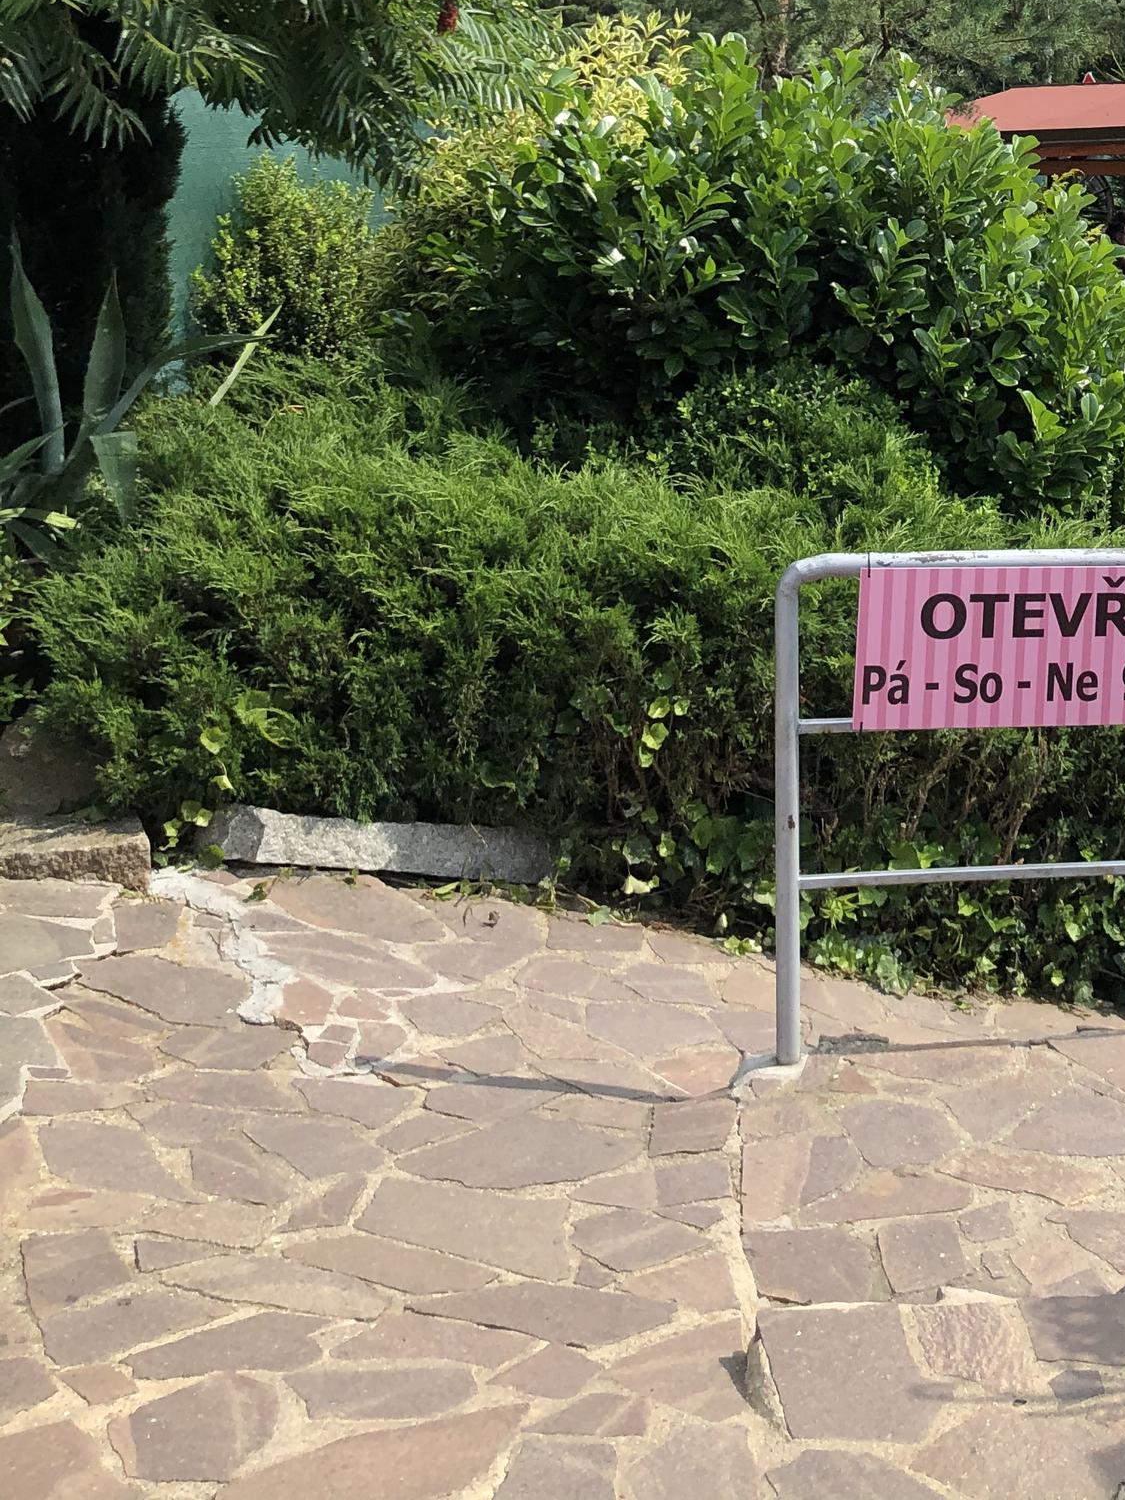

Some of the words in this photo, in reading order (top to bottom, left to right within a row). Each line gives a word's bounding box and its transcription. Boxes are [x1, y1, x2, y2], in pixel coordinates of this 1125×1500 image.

[862, 660, 910, 705] Pá
[953, 663, 1003, 703] So
[1047, 662, 1098, 702] Ne
